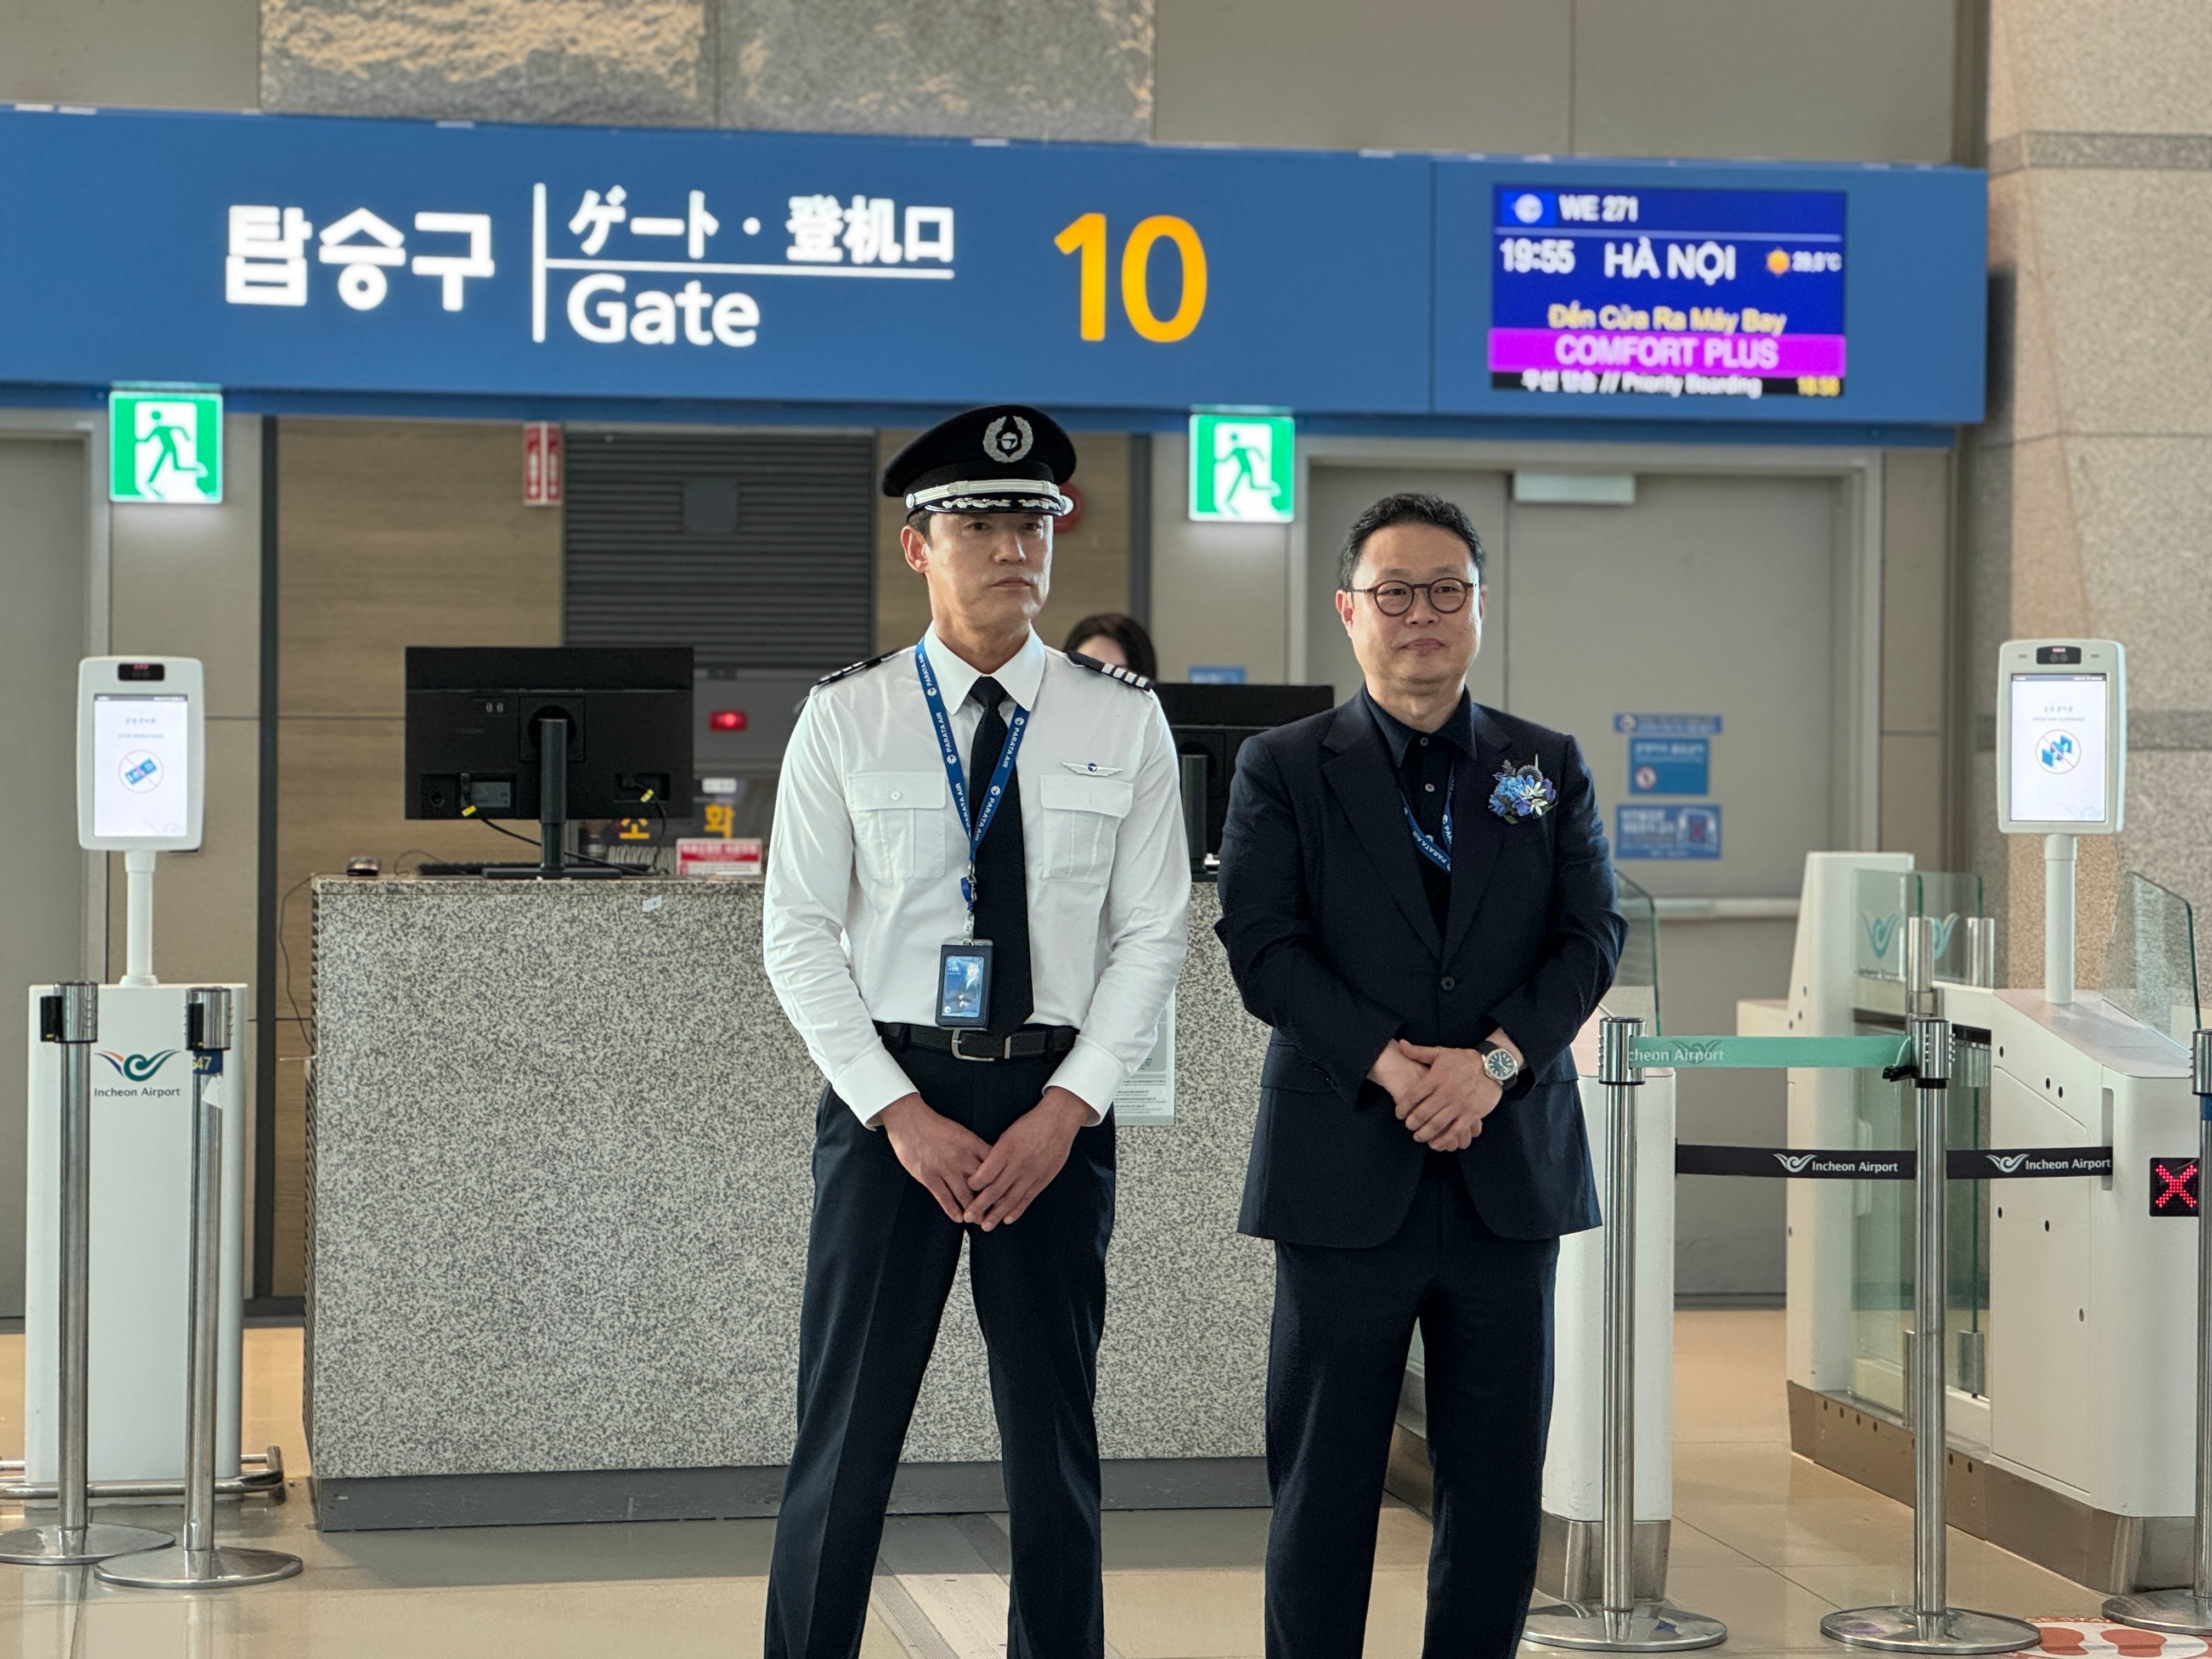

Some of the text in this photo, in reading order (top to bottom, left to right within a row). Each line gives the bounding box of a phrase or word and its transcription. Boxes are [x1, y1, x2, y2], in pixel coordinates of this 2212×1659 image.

[568, 184, 719, 259] ゲート
[1559, 194, 1639, 222] WE 271
[785, 195, 955, 264] 登机口
[225, 205, 495, 312] 탑승구
[1499, 238, 1576, 274] 19:55
[1604, 235, 1661, 279] HÀ
[1053, 213, 1207, 343] 10
[567, 274, 761, 347] Gate
[1653, 306, 1687, 331] Ra
[1741, 308, 1788, 338] Bay
[1555, 334, 1779, 370] COMFORT PLUS
[935, 712, 952, 753] PARATA AIR
[1002, 727, 1020, 769] PARATA AIR
[955, 782, 963, 795] AIR
[978, 797, 995, 827] PARATA
[1421, 840, 1447, 864] PARATA
[1628, 1048, 1725, 1064] cheon Airport
[94, 1087, 180, 1098] Incheon Airport
[1812, 1161, 1899, 1173] Incheon Airport
[2025, 1158, 2112, 1170] Incheon Airport
